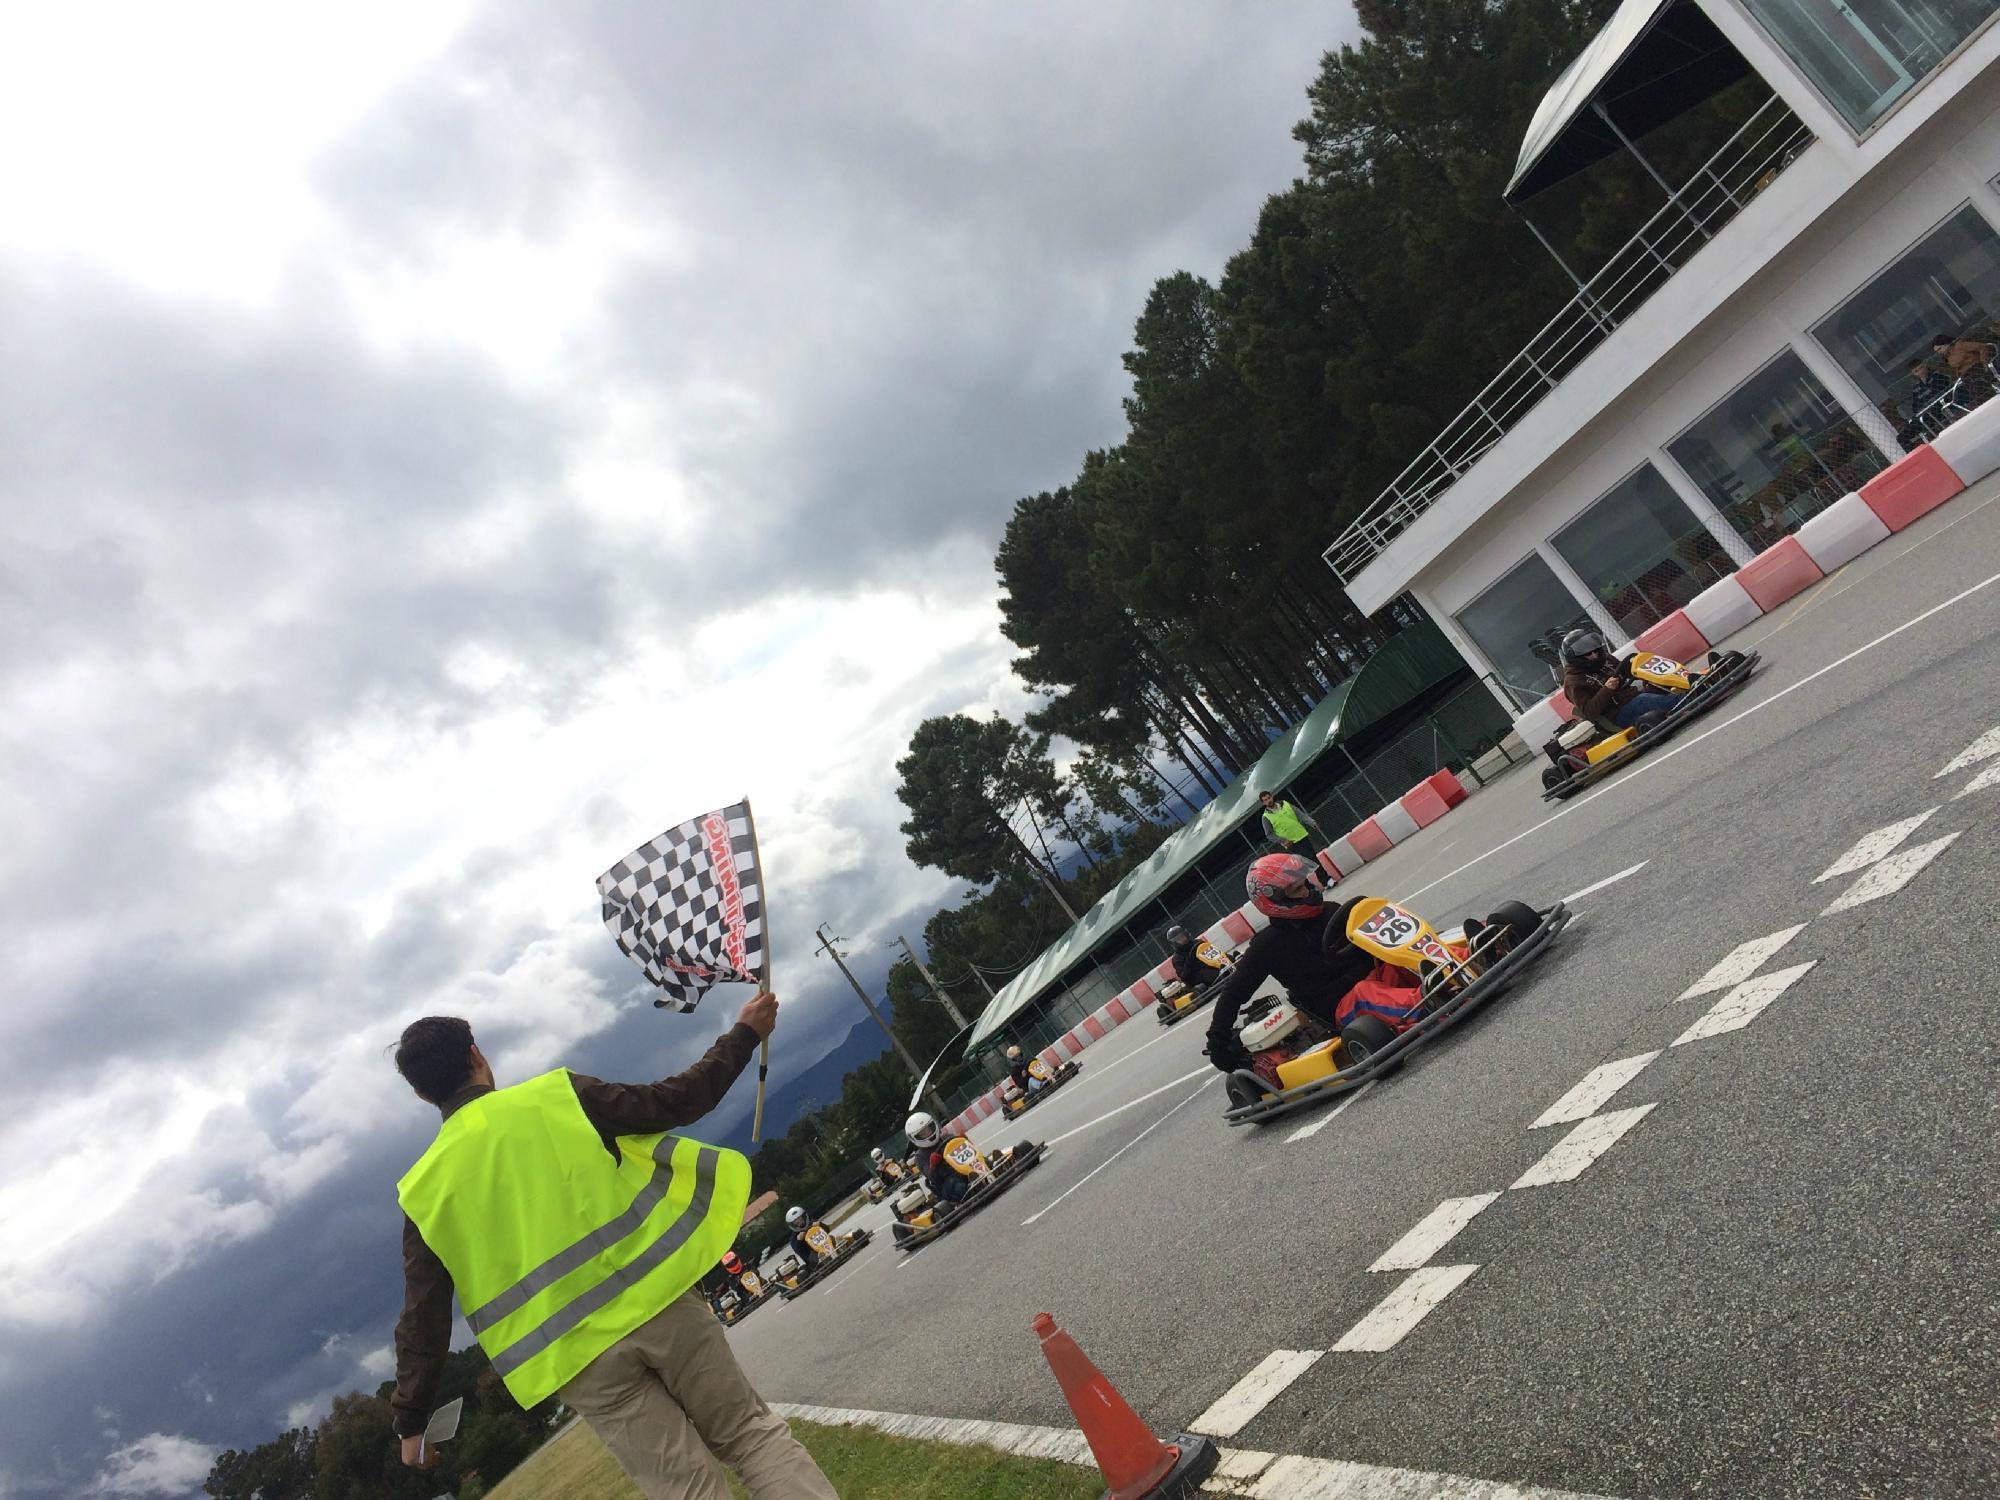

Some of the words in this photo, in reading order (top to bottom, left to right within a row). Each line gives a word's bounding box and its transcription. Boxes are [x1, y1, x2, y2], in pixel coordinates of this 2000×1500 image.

[1653, 661, 1671, 673] 27
[1380, 918, 1411, 943] 26
[957, 1150, 973, 1163] 28
